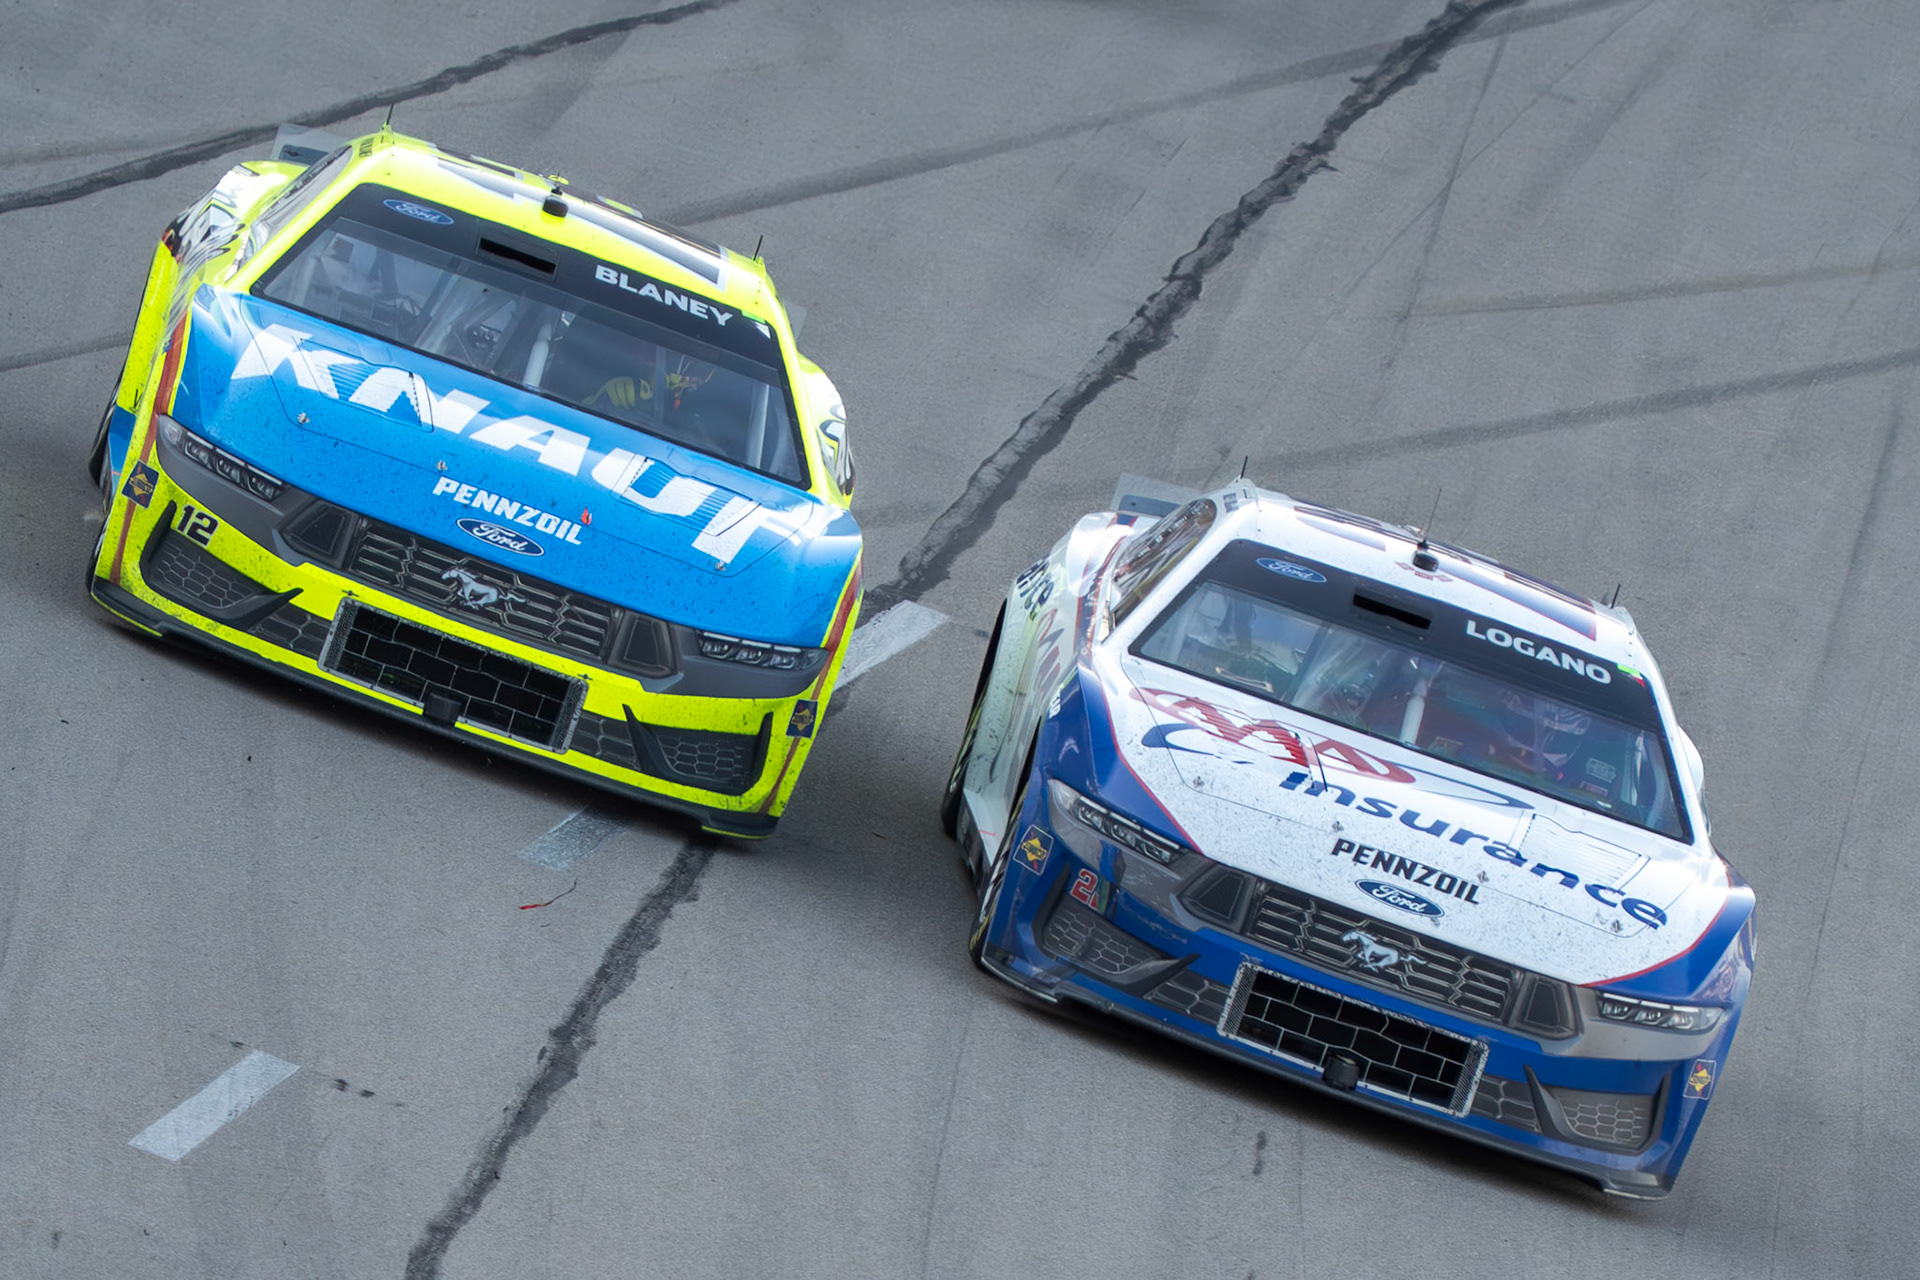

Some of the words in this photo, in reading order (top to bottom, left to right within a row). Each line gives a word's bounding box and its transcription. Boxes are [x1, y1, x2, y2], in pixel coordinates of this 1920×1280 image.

[594, 265, 733, 327] BLANEY
[177, 504, 219, 548] 12
[432, 476, 582, 545] PENNZOIL
[468, 522, 531, 552] Ford
[1466, 619, 1612, 685] LOGANO
[1069, 868, 1098, 911] 2
[1331, 838, 1480, 905] PENNZOIL
[1368, 883, 1430, 914] Ford
